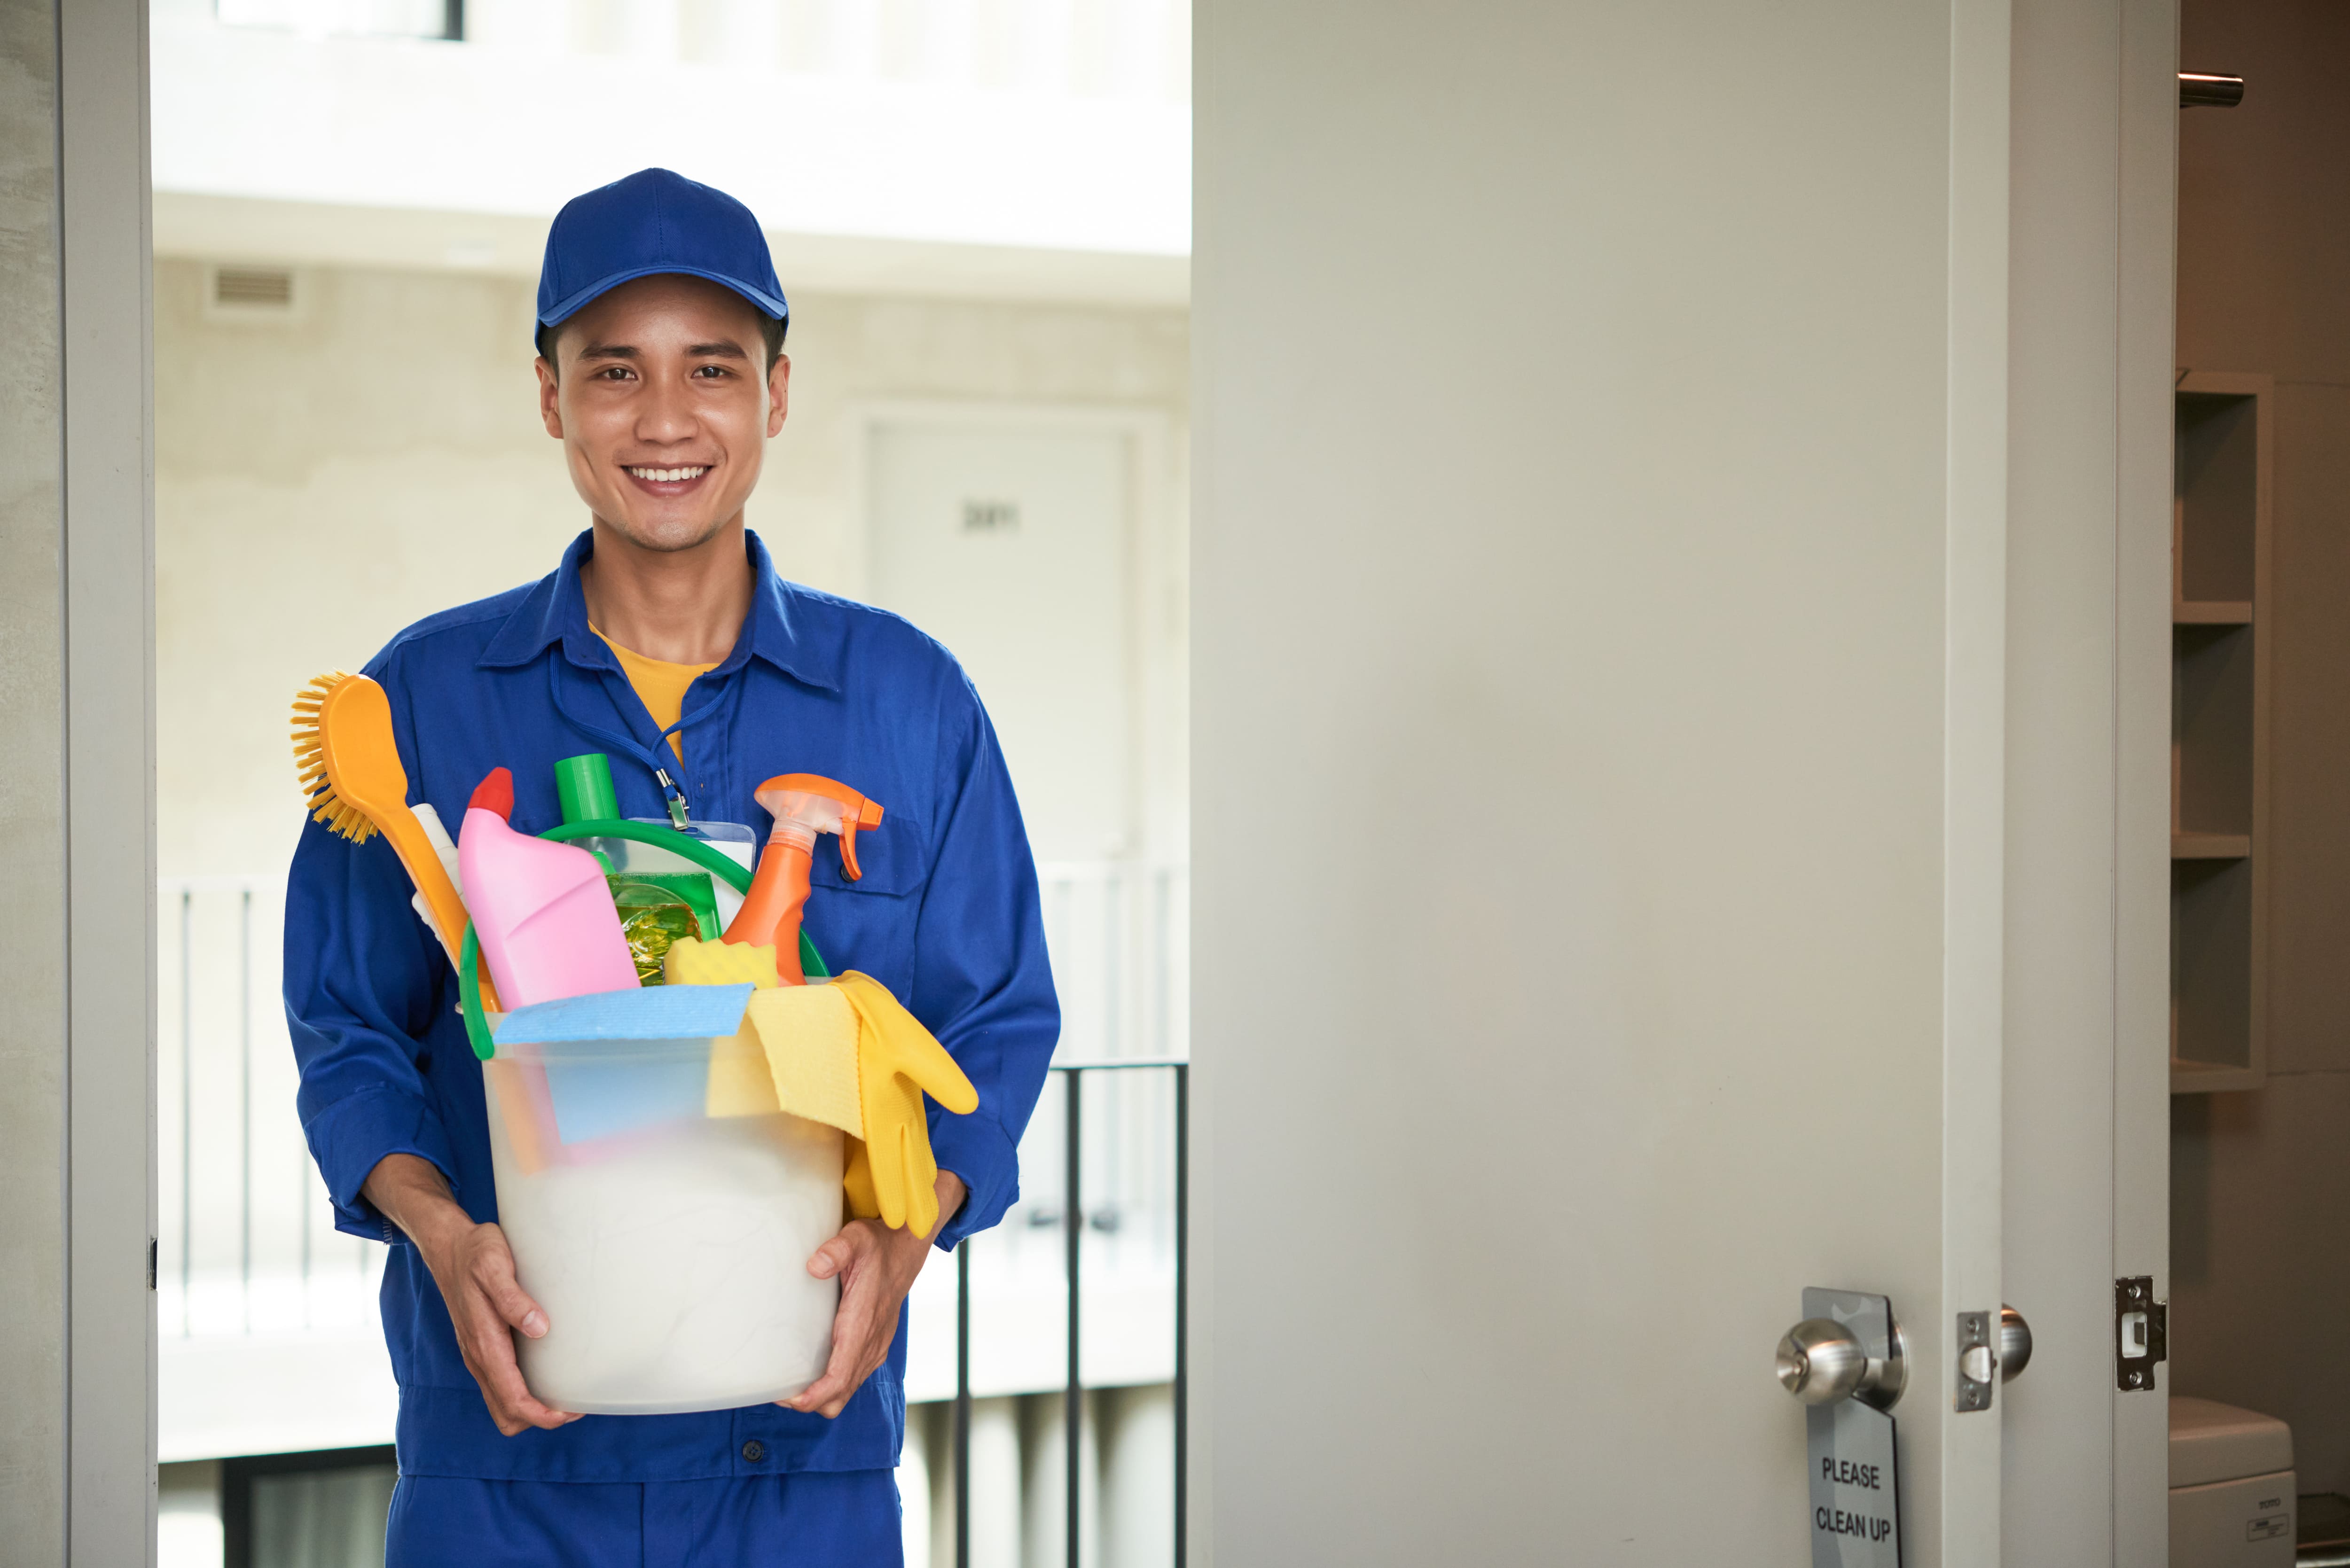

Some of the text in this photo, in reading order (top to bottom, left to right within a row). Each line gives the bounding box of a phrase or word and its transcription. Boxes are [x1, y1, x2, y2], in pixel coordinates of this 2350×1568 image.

[1822, 1457, 1880, 1490] PLEASE
[1817, 1506, 1890, 1543] CLEAN UP
